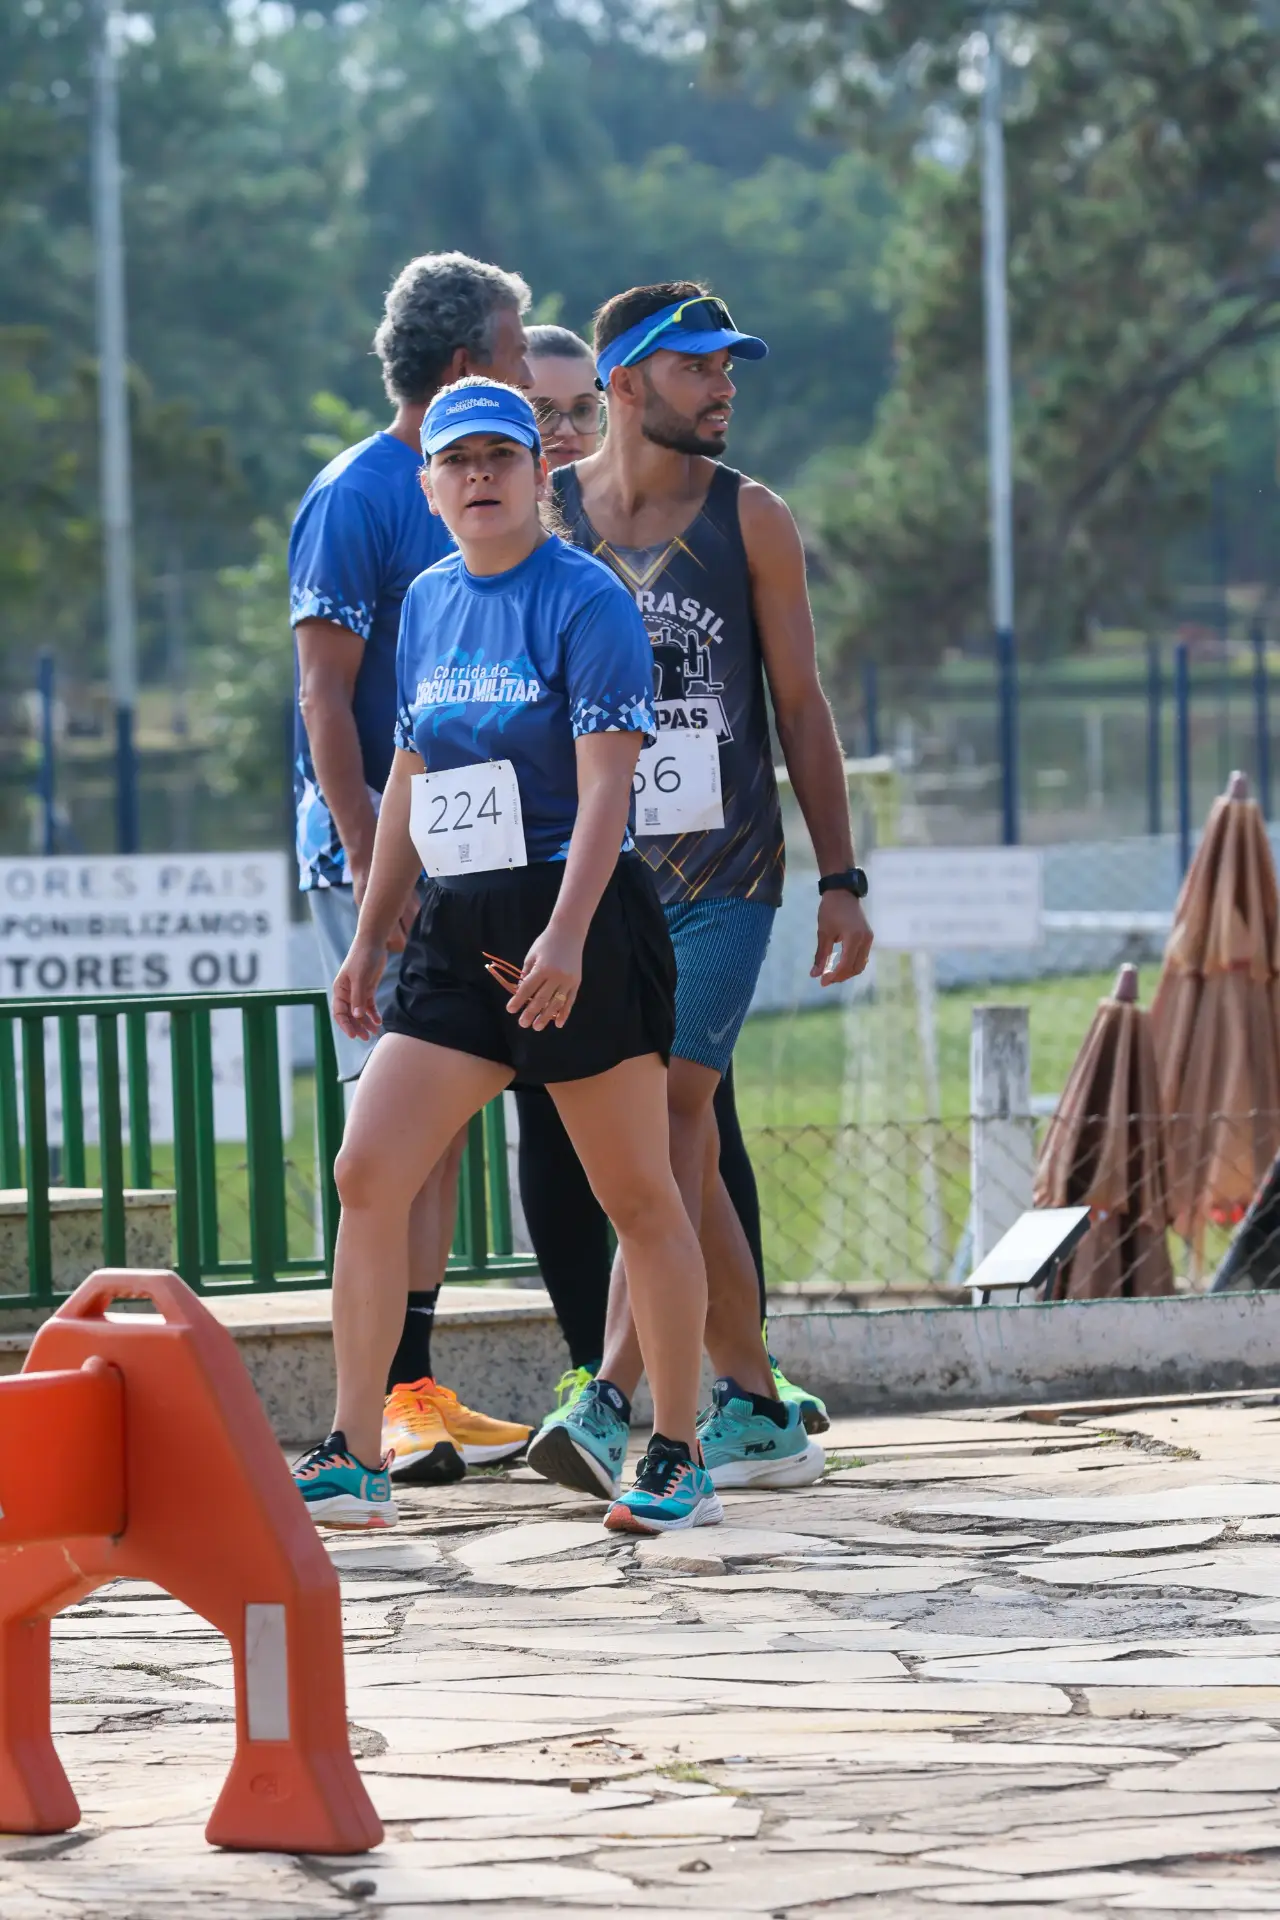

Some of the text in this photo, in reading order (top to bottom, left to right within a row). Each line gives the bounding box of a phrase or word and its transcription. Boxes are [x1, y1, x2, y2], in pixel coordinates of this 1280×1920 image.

[635, 590, 724, 645] RASIL
[433, 663, 509, 680] Corrida do
[471, 678, 540, 703] MILITAR
[655, 706, 709, 730] PAS
[427, 786, 503, 835] 224
[5, 864, 266, 900] ORES PAIS
[0, 911, 271, 939] PONIBILIZAMOS
[5, 950, 259, 990] TORES OU
[744, 1440, 777, 1456] FILA
